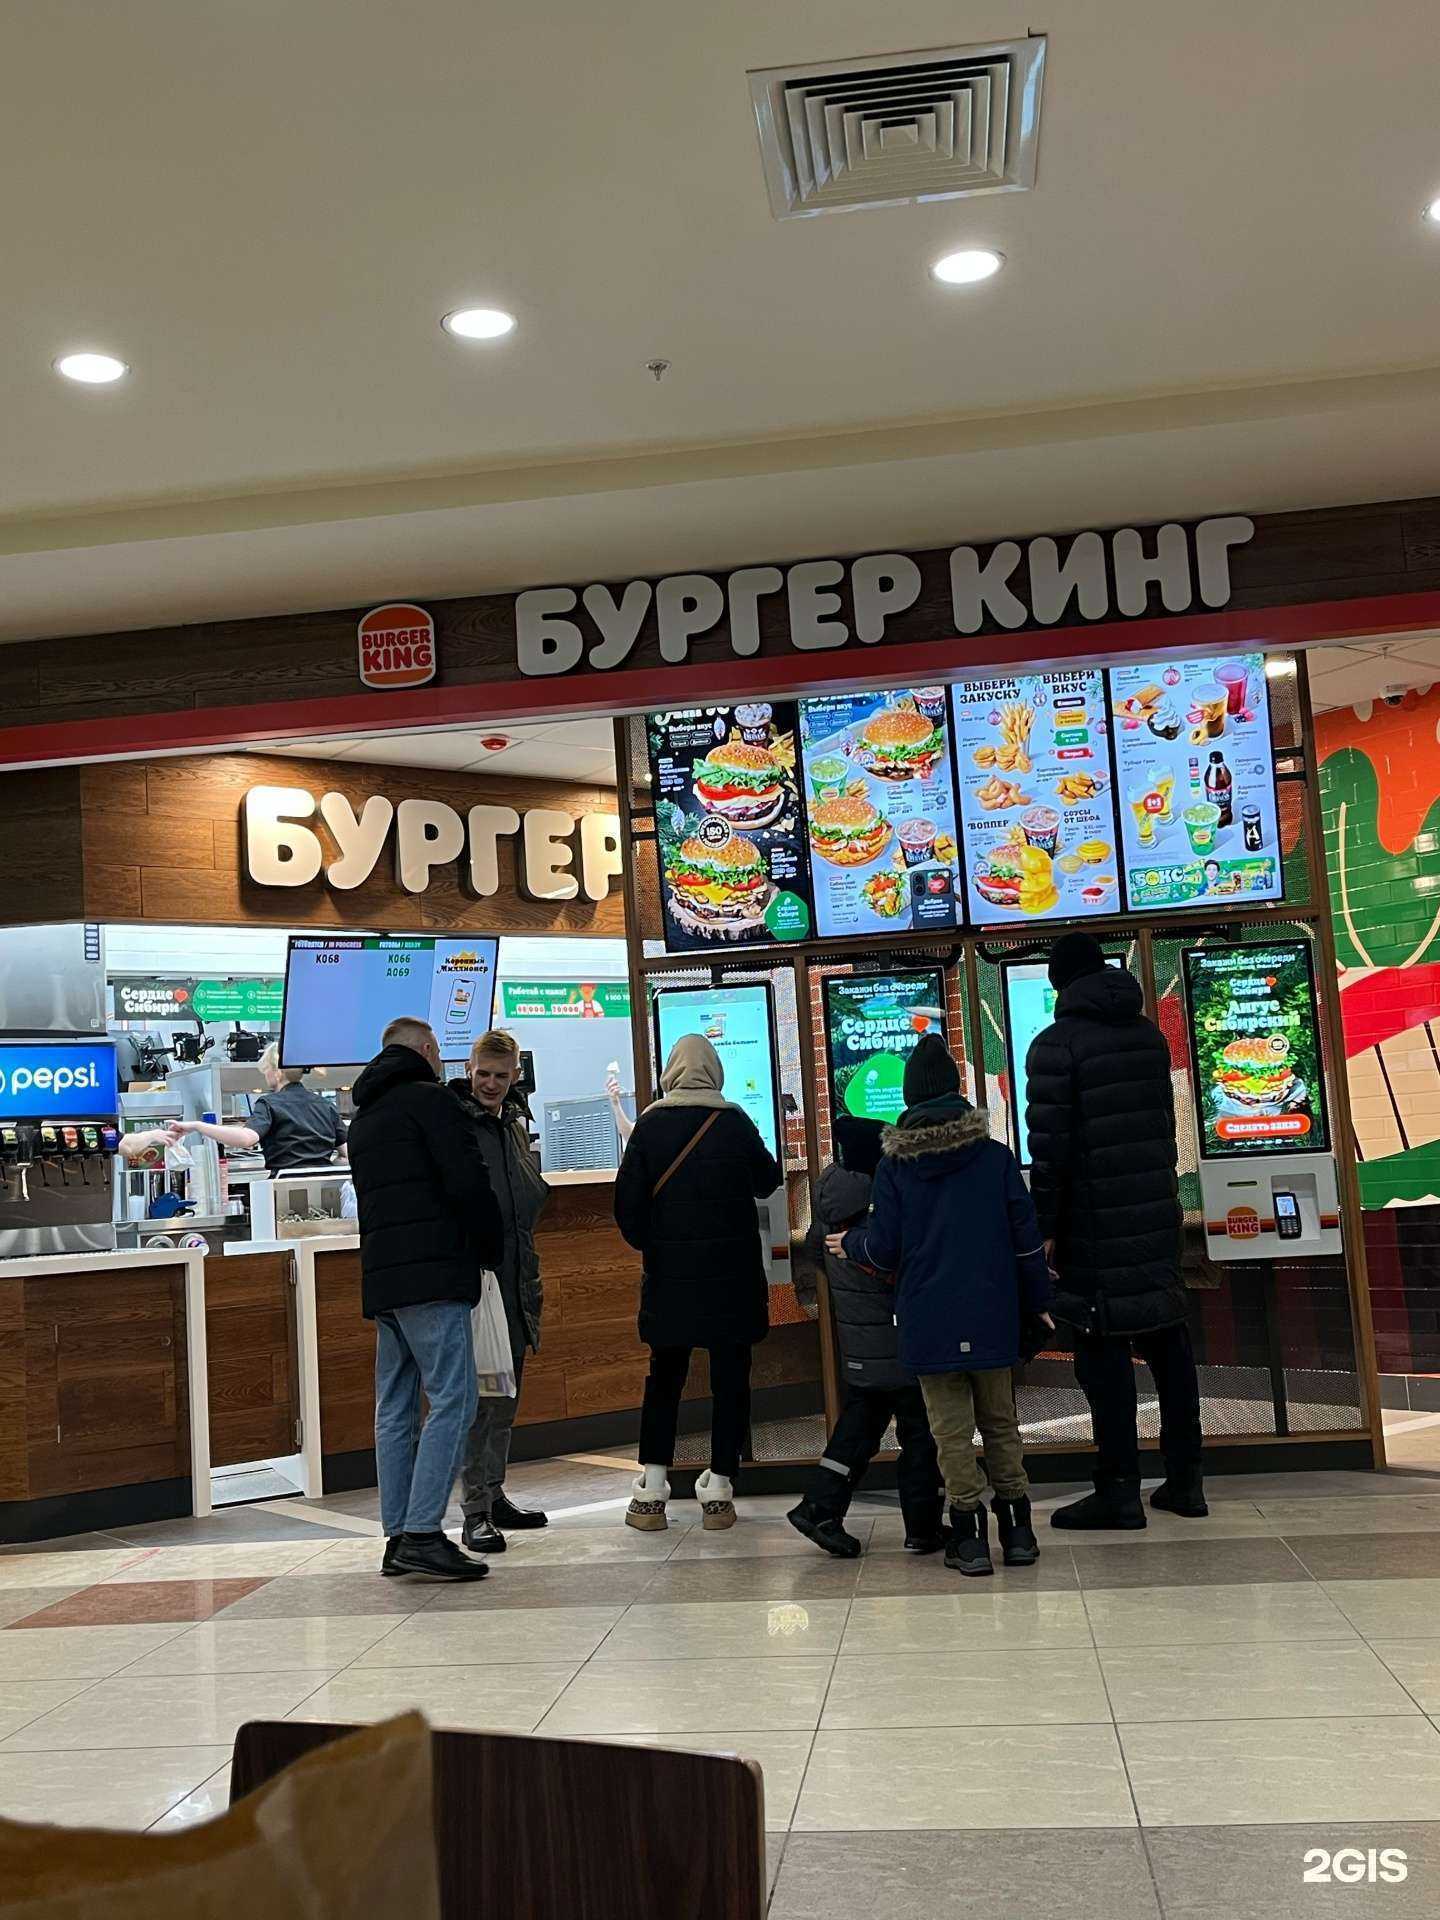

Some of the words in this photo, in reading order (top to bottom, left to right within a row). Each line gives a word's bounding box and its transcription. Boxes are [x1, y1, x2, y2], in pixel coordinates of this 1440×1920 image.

[515, 553, 921, 676] БУРГЕР
[949, 516, 1255, 634] КИНГ
[361, 628, 431, 650] BURGER
[363, 645, 433, 672] KING
[1043, 670, 1095, 684] ВЫБЕРИ
[964, 680, 1016, 692] ВЫБЕРИ
[1053, 682, 1087, 694] ВКУС
[960, 689, 1021, 704] ЗАКУСКУ
[1064, 809, 1091, 817] СОУСЫ
[1076, 815, 1101, 823] ШЕФА
[245, 785, 624, 901] БУРГЕР
[437, 964, 489, 975] Миллионер
[445, 957, 485, 966] Коронный
[120, 987, 174, 1003] Сердце
[838, 986, 872, 995] Закажи
[873, 983, 889, 992] без
[124, 1000, 180, 1016] Сибири
[1222, 1000, 1280, 1017] Ангус
[841, 1016, 910, 1037] Сердце
[1204, 1010, 1301, 1032] Сибирский
[847, 1033, 919, 1052] Сибири
[11, 1062, 98, 1096] pepsi
[1228, 1222, 1260, 1234] KING
